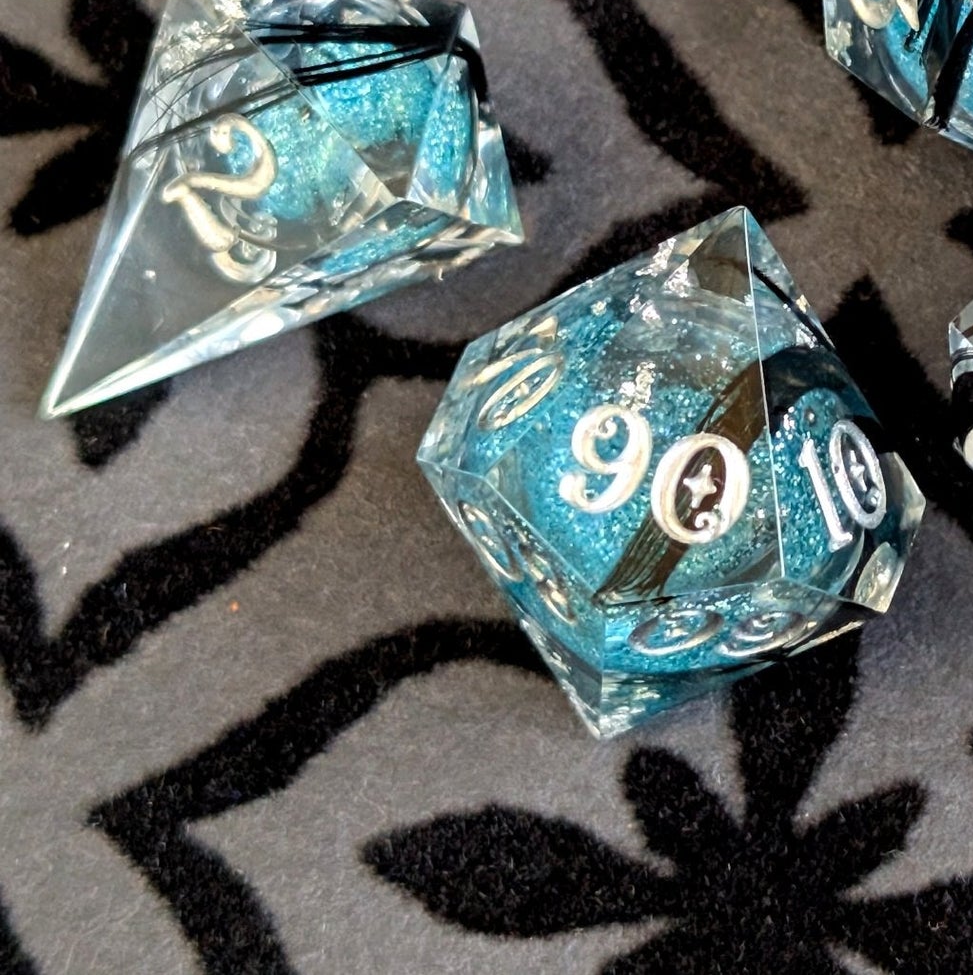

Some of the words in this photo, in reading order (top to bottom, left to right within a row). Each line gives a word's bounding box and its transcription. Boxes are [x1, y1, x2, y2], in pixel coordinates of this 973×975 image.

[162, 113, 278, 254] 2
[558, 402, 751, 545] 90
[797, 417, 887, 554] 10
